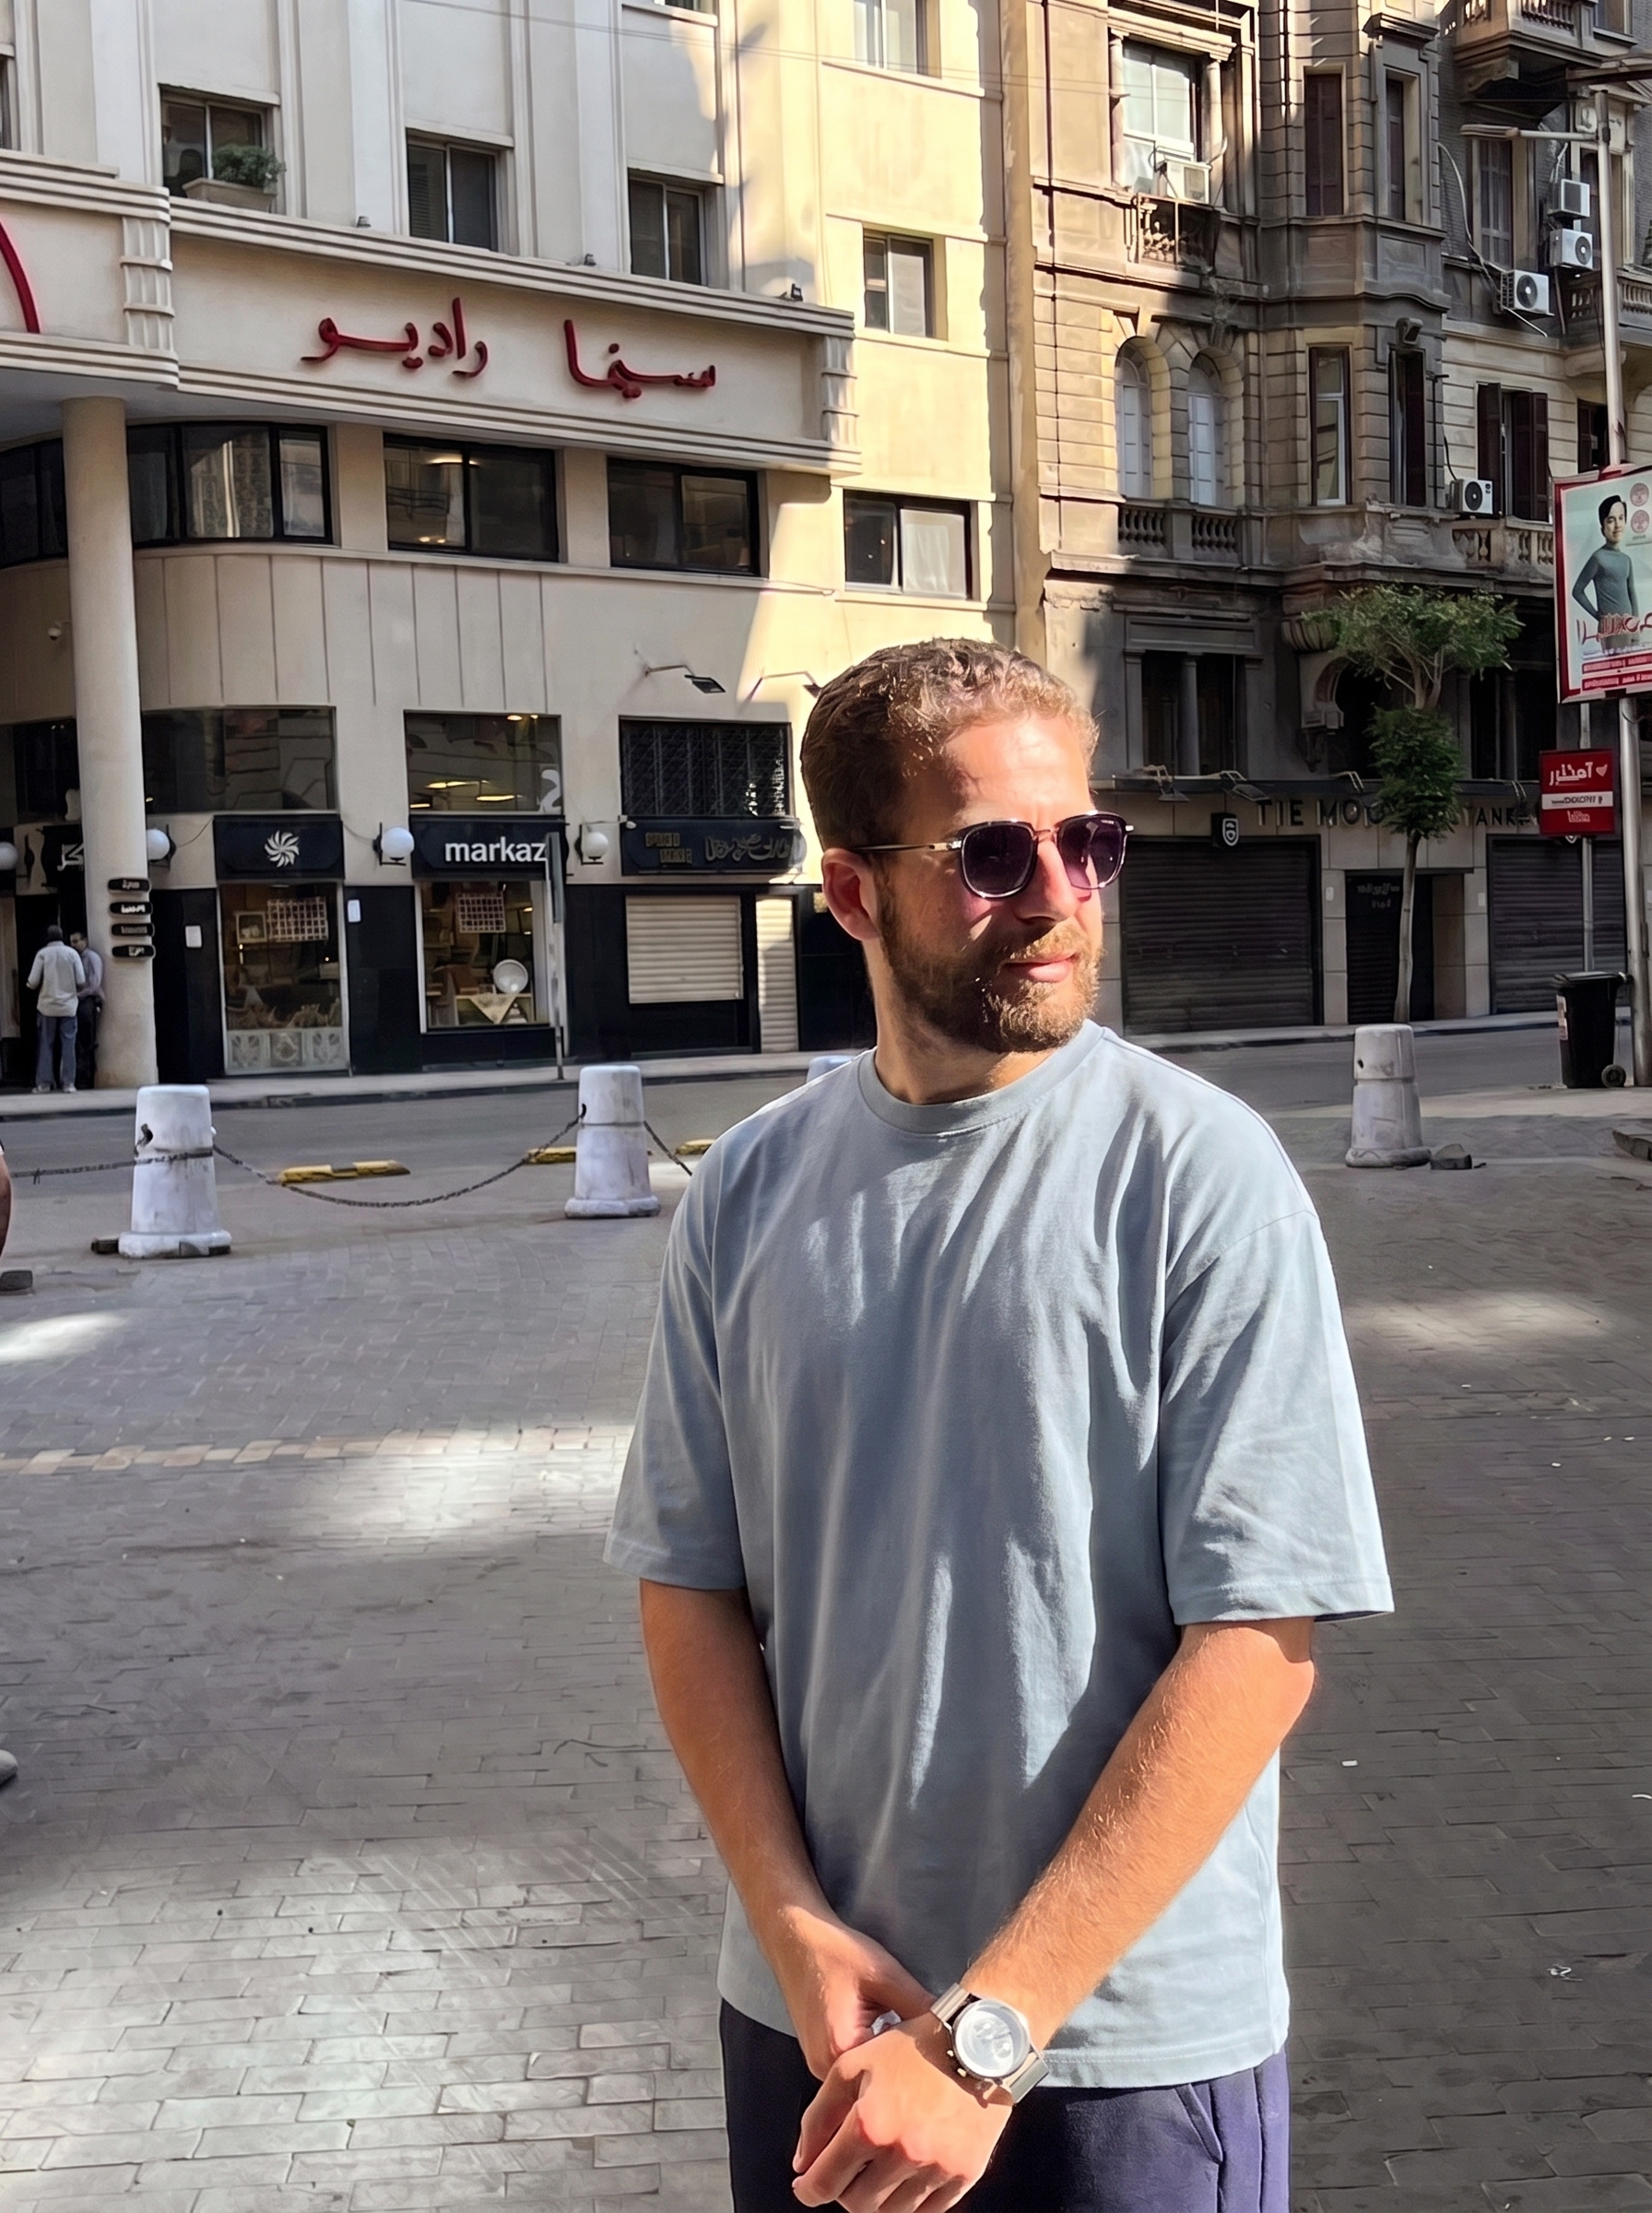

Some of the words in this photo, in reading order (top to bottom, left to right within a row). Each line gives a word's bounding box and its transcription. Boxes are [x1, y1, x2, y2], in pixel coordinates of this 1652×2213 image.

[300, 296, 490, 379] راديو
[563, 317, 717, 399] سينما
[444, 835, 547, 863] markaz
